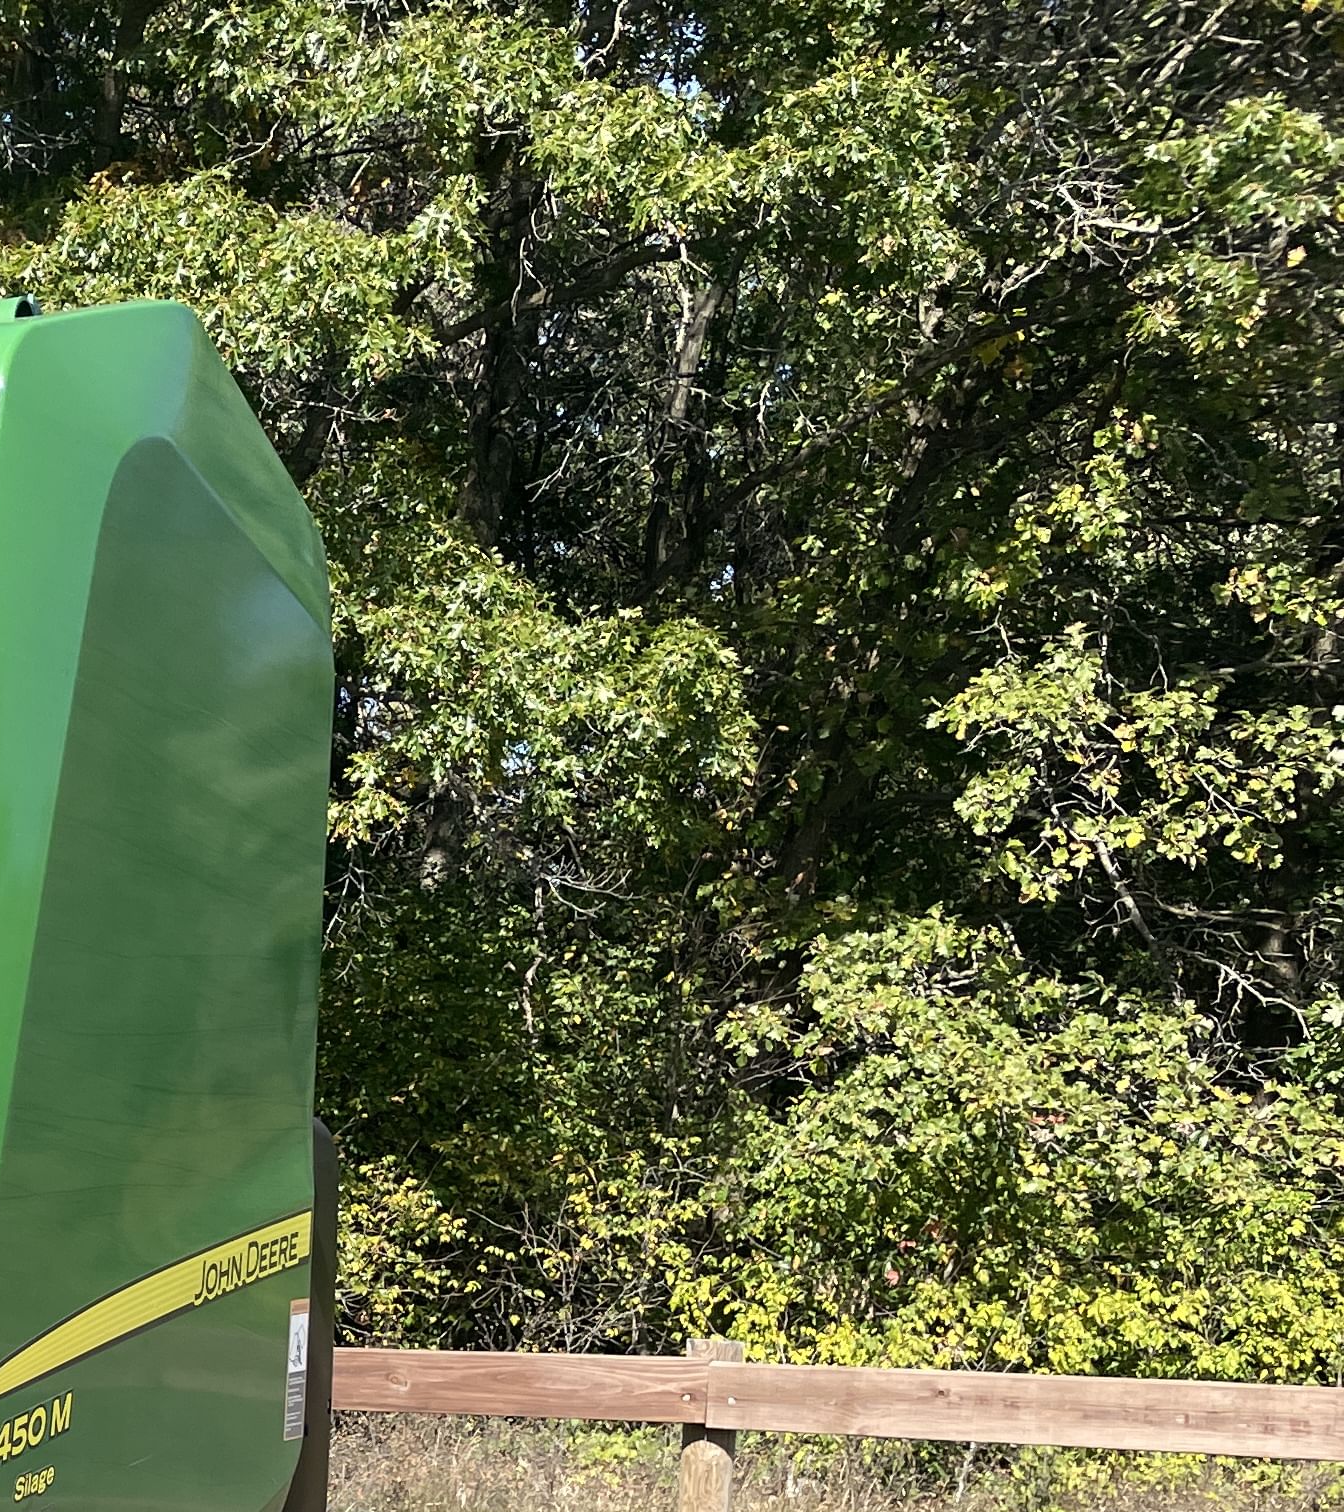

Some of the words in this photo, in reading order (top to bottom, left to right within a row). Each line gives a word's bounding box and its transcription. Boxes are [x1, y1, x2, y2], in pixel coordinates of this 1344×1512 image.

[196, 1254, 243, 1300] JOHN
[246, 1232, 299, 1279] DEERE
[50, 1391, 73, 1437] M
[14, 1466, 56, 1501] Silage
